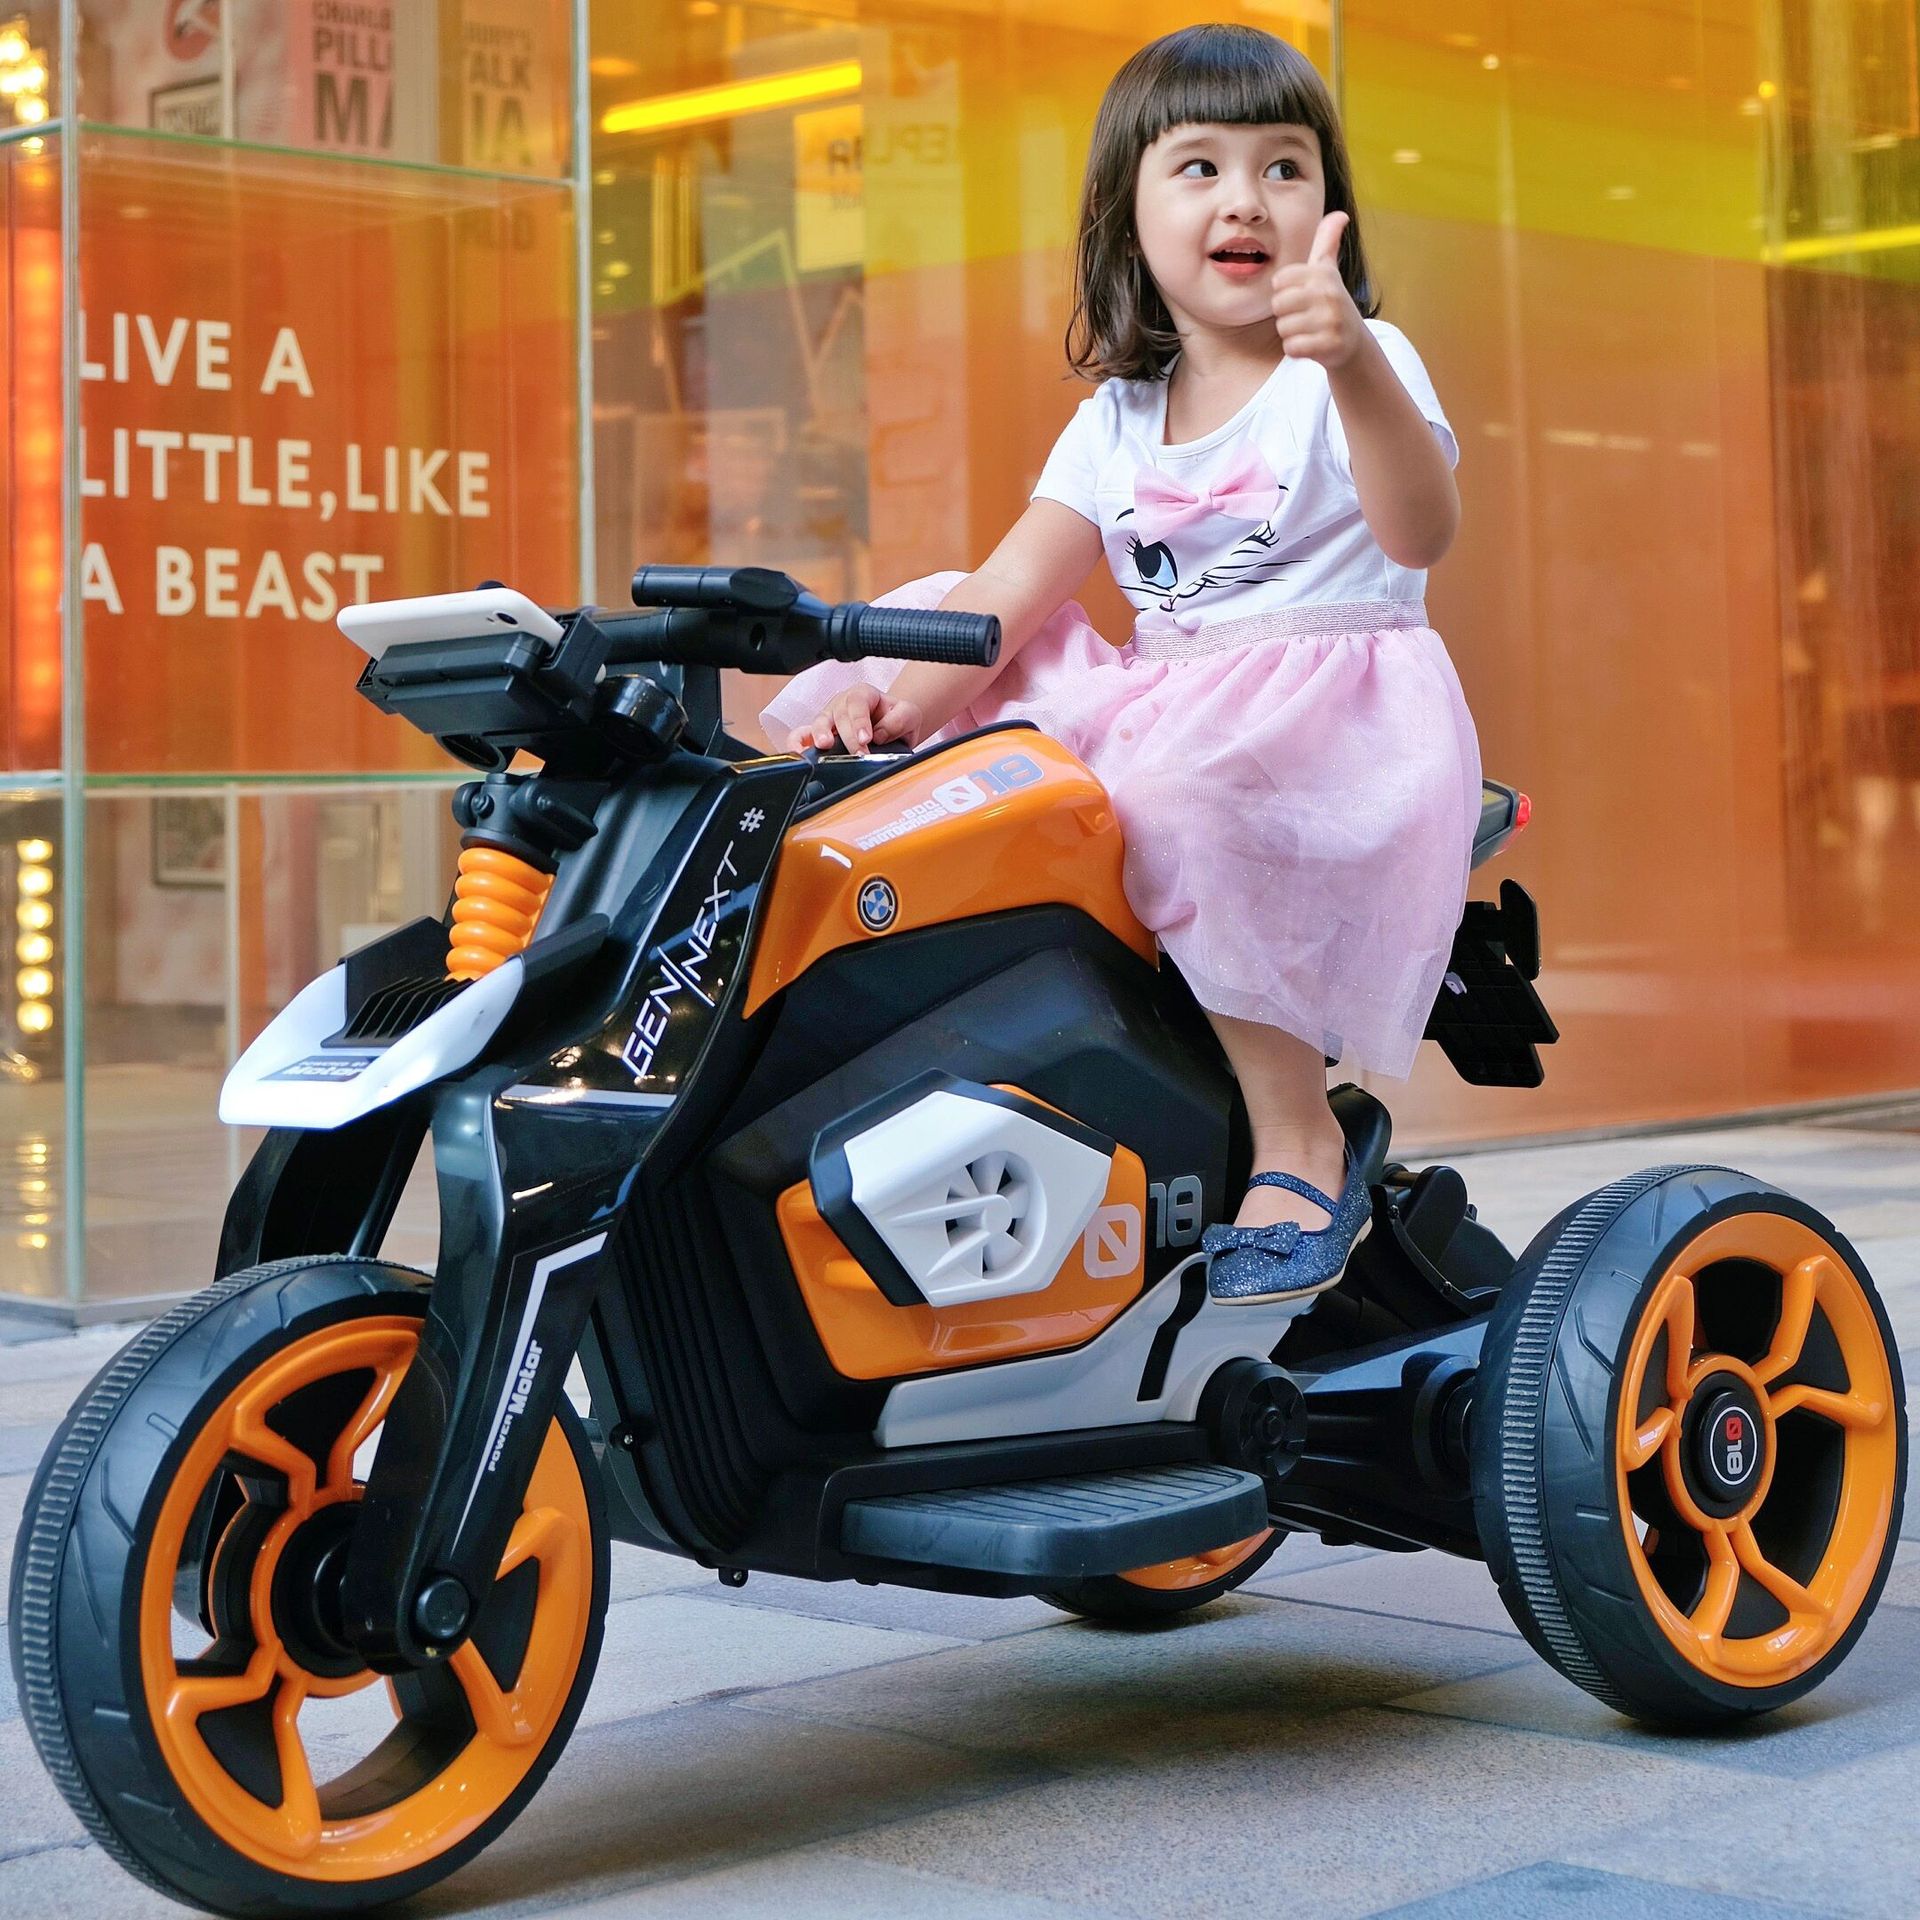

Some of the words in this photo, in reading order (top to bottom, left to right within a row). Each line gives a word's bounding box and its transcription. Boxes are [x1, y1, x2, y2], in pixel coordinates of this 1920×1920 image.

[79, 309, 232, 391] LIVE
[259, 326, 315, 398] A
[80, 542, 125, 615] A
[156, 545, 384, 623] BEAST
[488, 1413, 514, 1473] POWER
[507, 1339, 543, 1415] Motor
